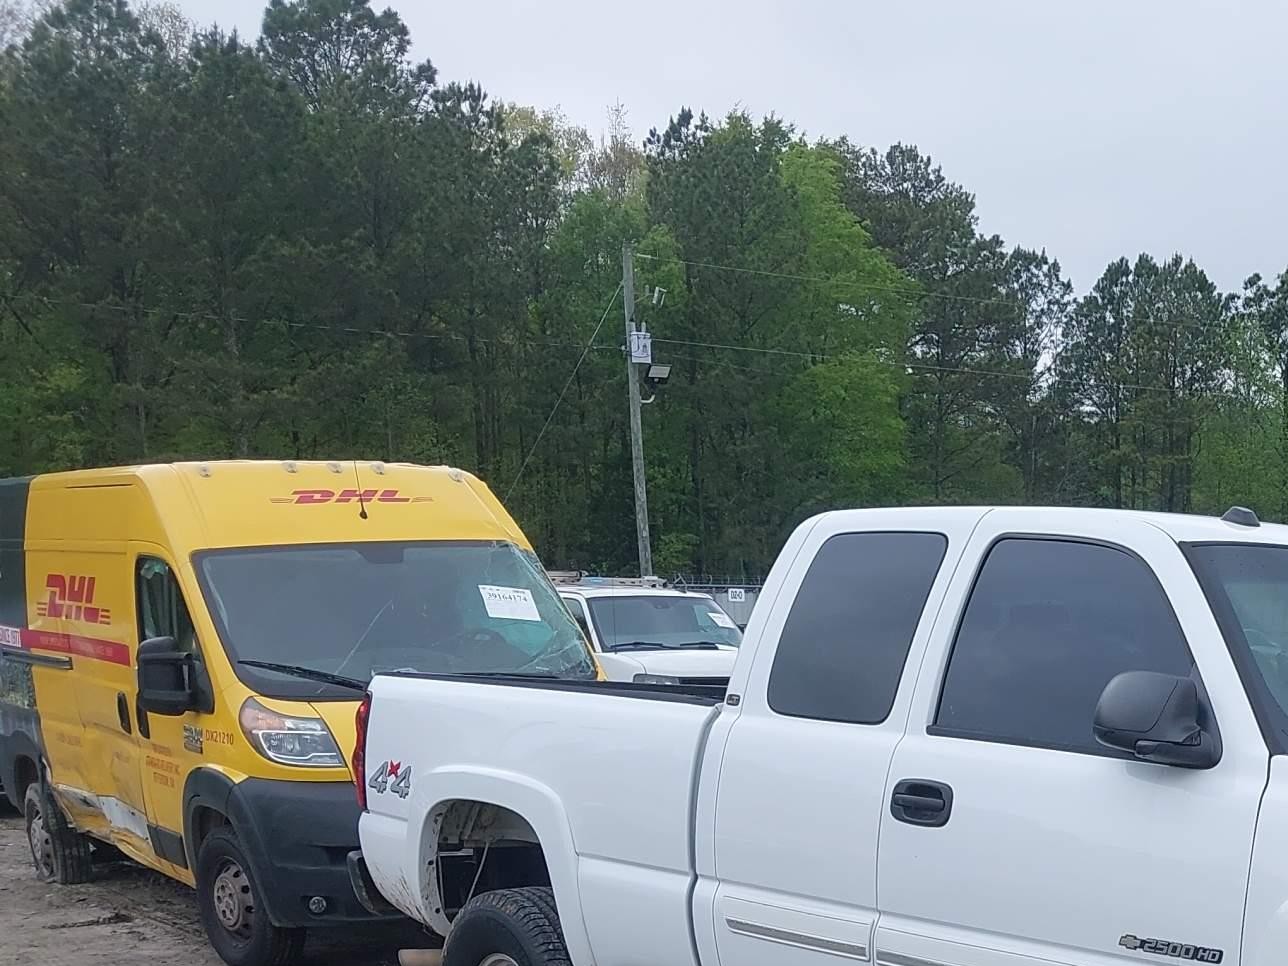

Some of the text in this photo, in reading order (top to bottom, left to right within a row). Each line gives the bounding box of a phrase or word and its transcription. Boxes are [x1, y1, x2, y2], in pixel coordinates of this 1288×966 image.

[291, 489, 410, 505] DHL
[46, 573, 100, 624] DHL
[1143, 938, 1197, 960] 2500
